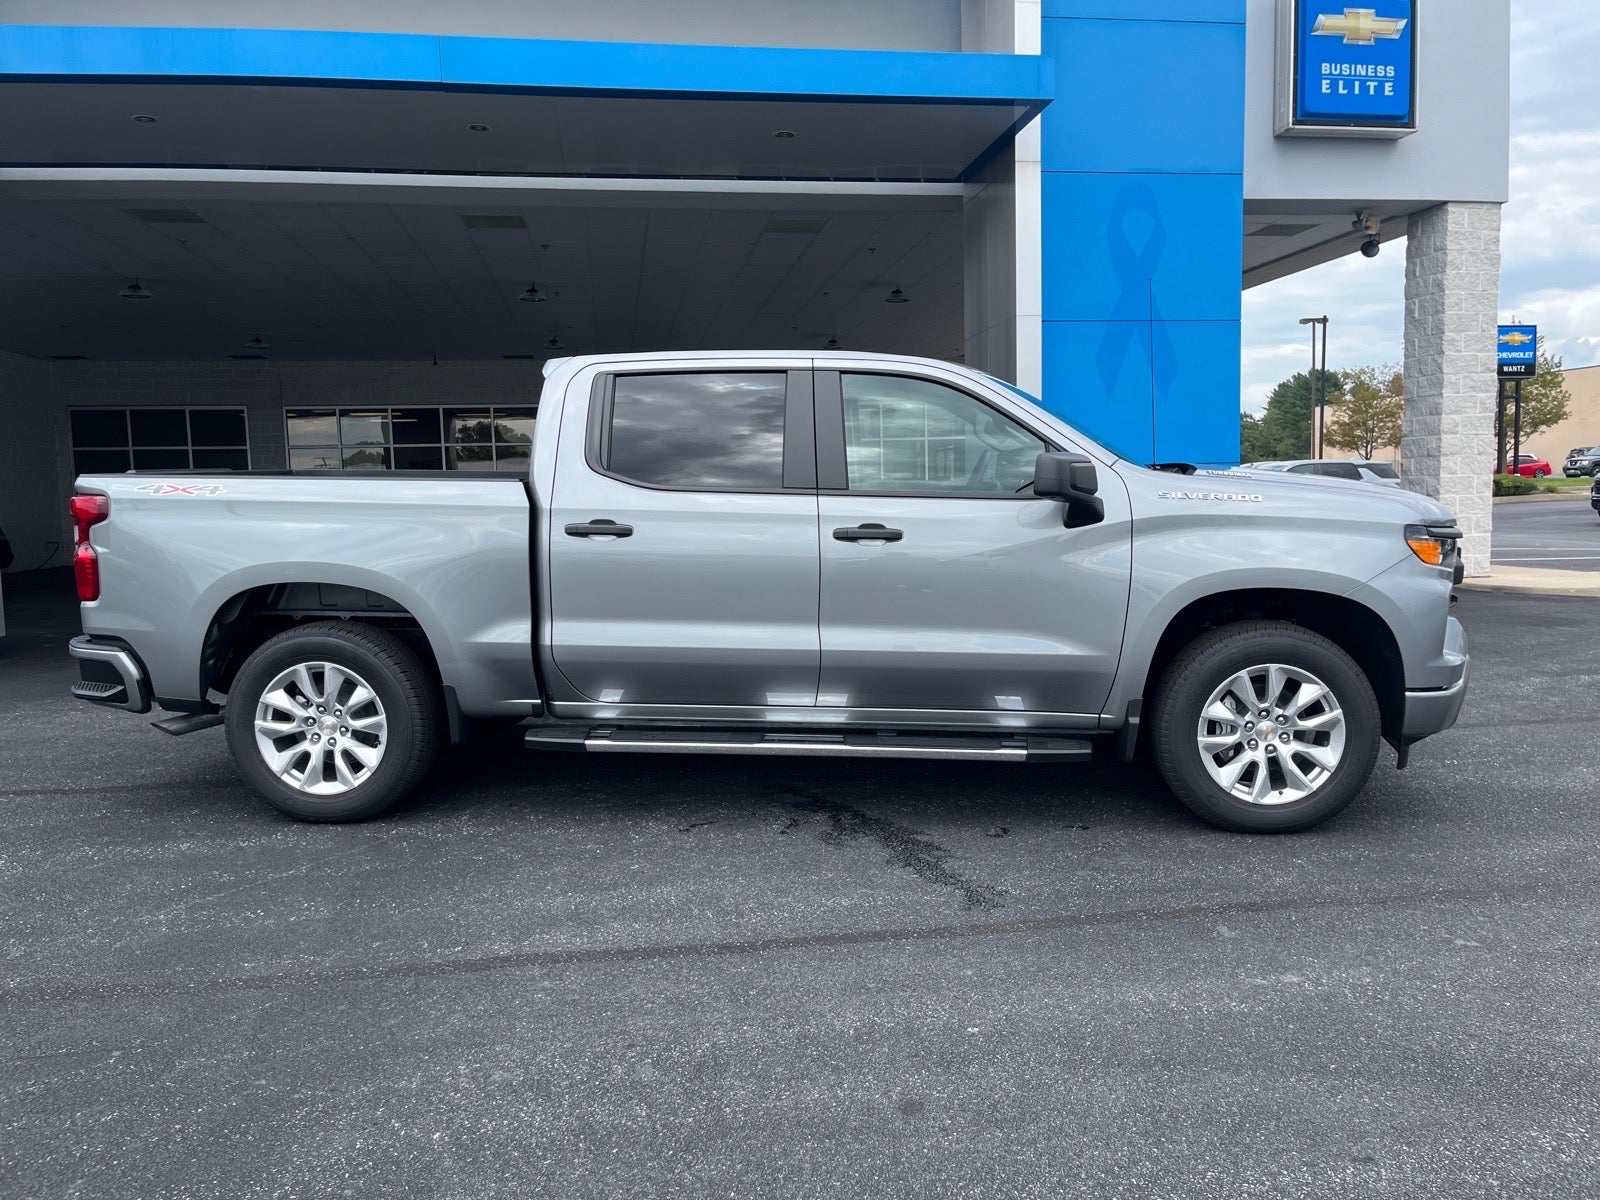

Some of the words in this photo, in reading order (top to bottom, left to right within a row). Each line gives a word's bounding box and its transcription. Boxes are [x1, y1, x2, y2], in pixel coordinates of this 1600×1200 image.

[1321, 63, 1395, 77] BUSINESS
[1321, 79, 1395, 96] ELITE
[1158, 490, 1263, 502] SILVERADO
